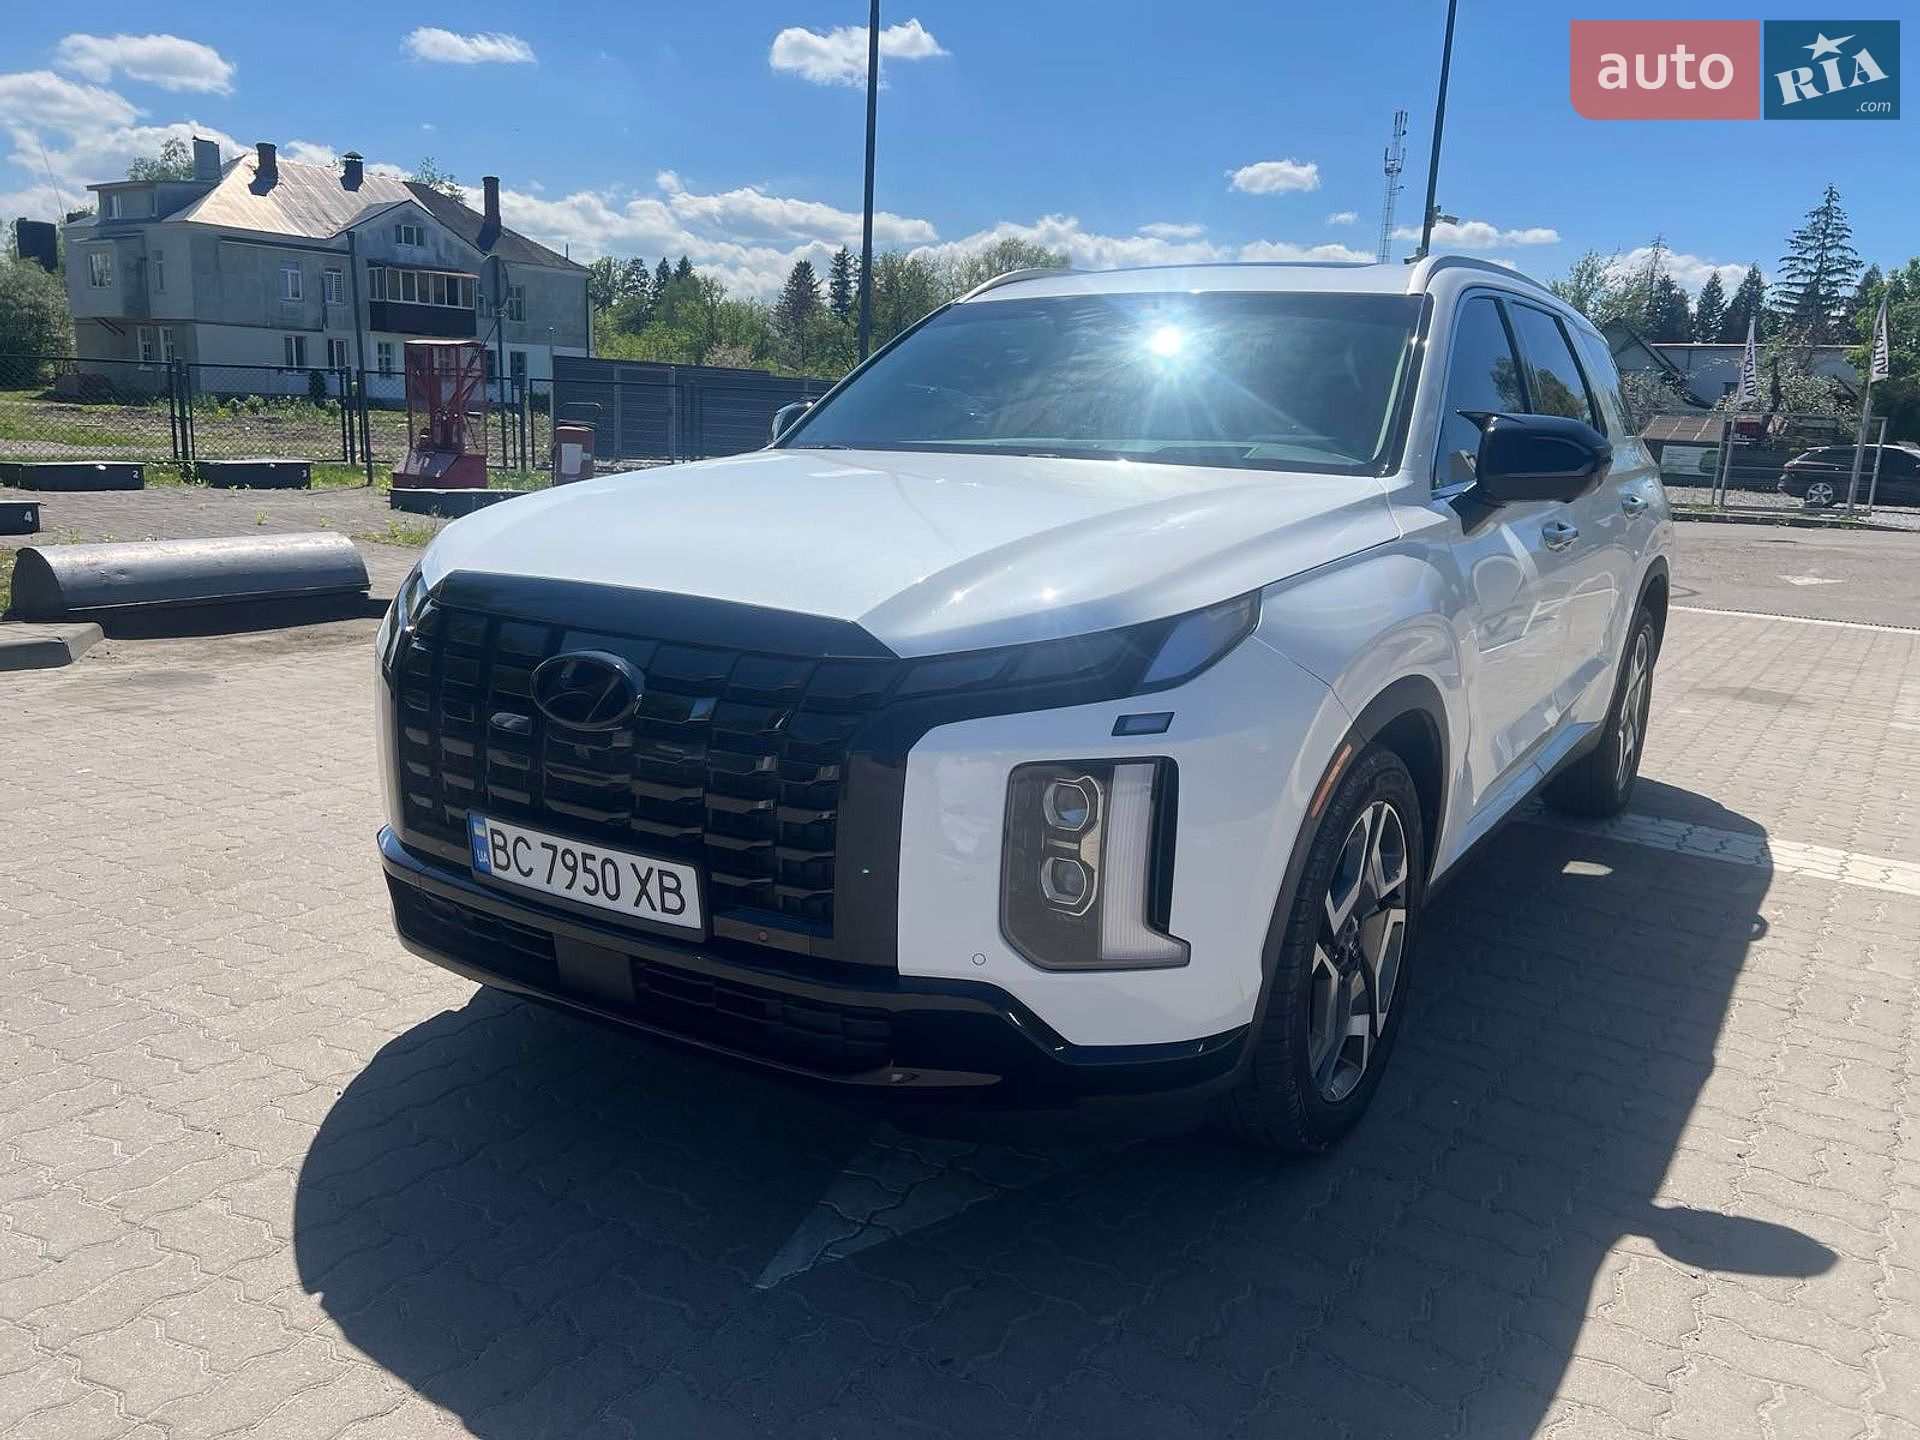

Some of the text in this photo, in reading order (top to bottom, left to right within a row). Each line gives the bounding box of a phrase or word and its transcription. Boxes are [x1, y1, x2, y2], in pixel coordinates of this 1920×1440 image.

[24, 511, 33, 522] 4
[476, 847, 490, 865] UA
[489, 827, 686, 915] BC 7950 XB
